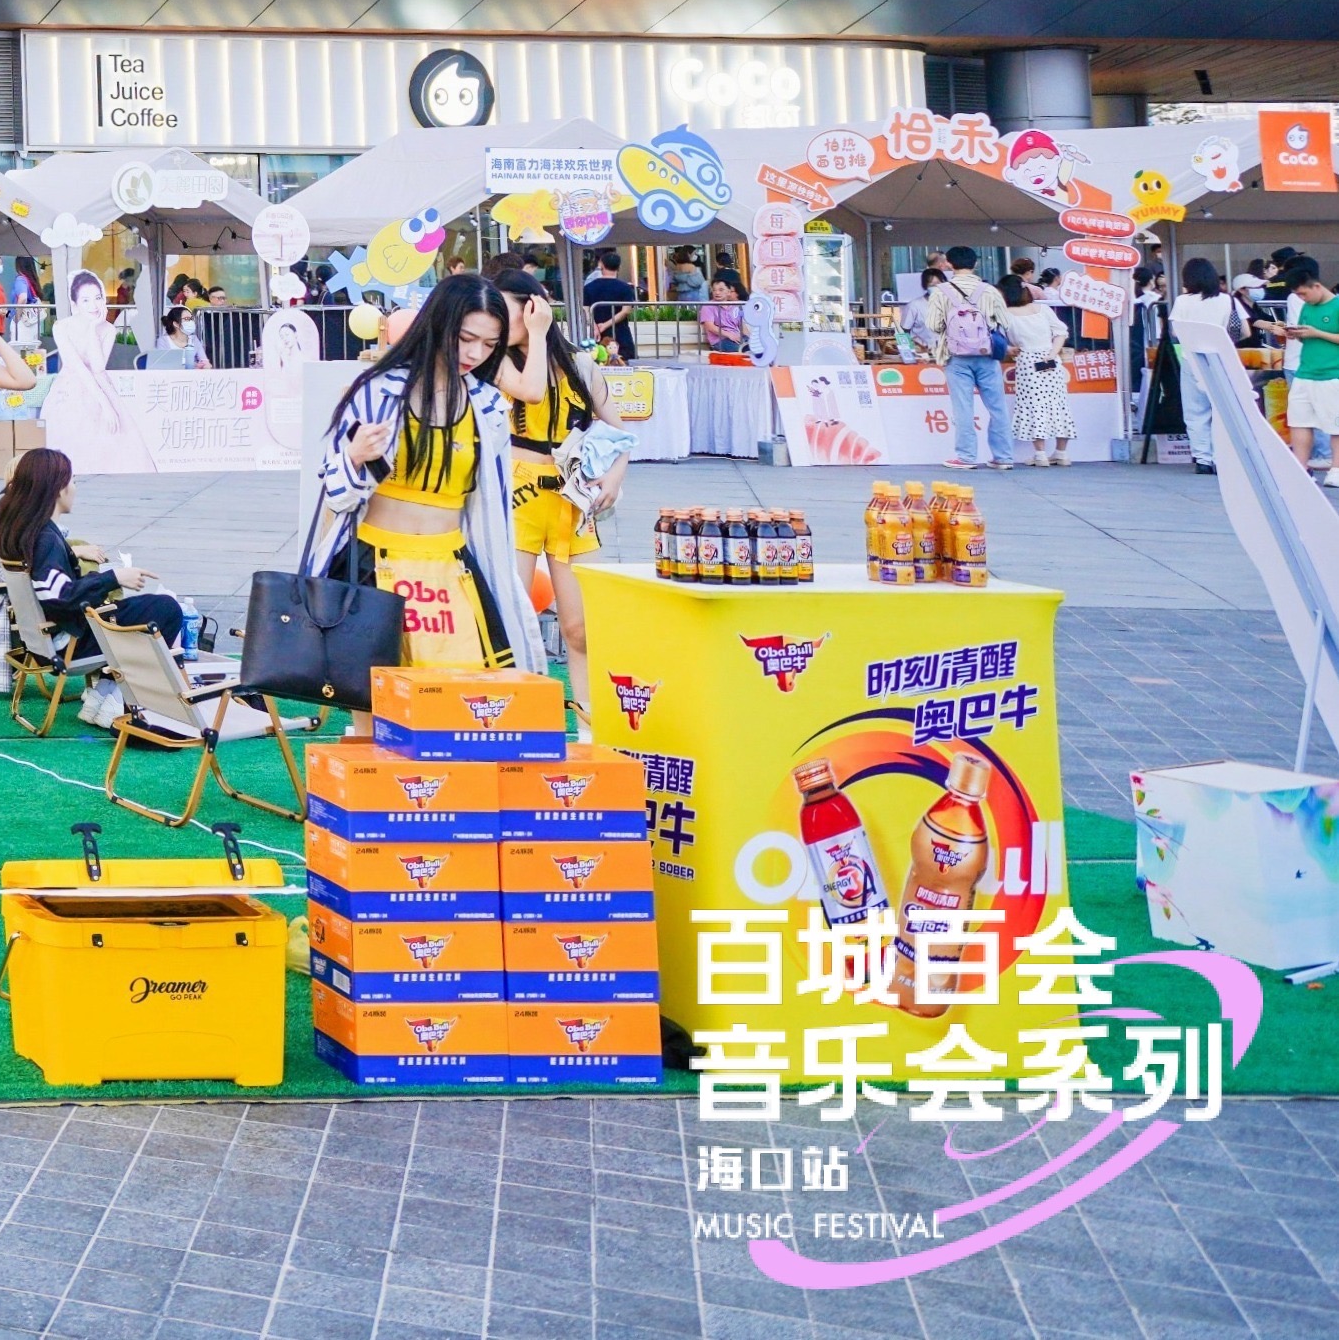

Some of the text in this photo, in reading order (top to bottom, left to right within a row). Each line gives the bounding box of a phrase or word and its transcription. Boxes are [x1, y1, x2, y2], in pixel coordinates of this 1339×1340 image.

[109, 54, 145, 74] Tea
[110, 81, 164, 101] Juice
[670, 58, 802, 107] CoCo
[110, 108, 179, 129] Coffee
[491, 158, 613, 172] 海南富力海洋欢乐世界
[1278, 152, 1319, 166] CoCo
[491, 172, 525, 180] HAINAN
[543, 173, 571, 181] OCEAN
[572, 173, 613, 181] PARADISE
[1132, 206, 1181, 221] YUMMY
[145, 377, 239, 413] 美丽邀约
[158, 416, 253, 452] 如期而至
[394, 579, 450, 605] Oba
[403, 608, 456, 635] Bull
[758, 643, 814, 658] Oba Bull
[765, 656, 807, 673] 奥巴牛
[866, 641, 1019, 697] 时刻清醒
[616, 685, 652, 699] Oba Bull
[913, 685, 1039, 746] 奥巴牛
[659, 861, 696, 880] SOBER
[823, 877, 853, 893] ENERGY
[129, 976, 209, 1004] Dreamer
